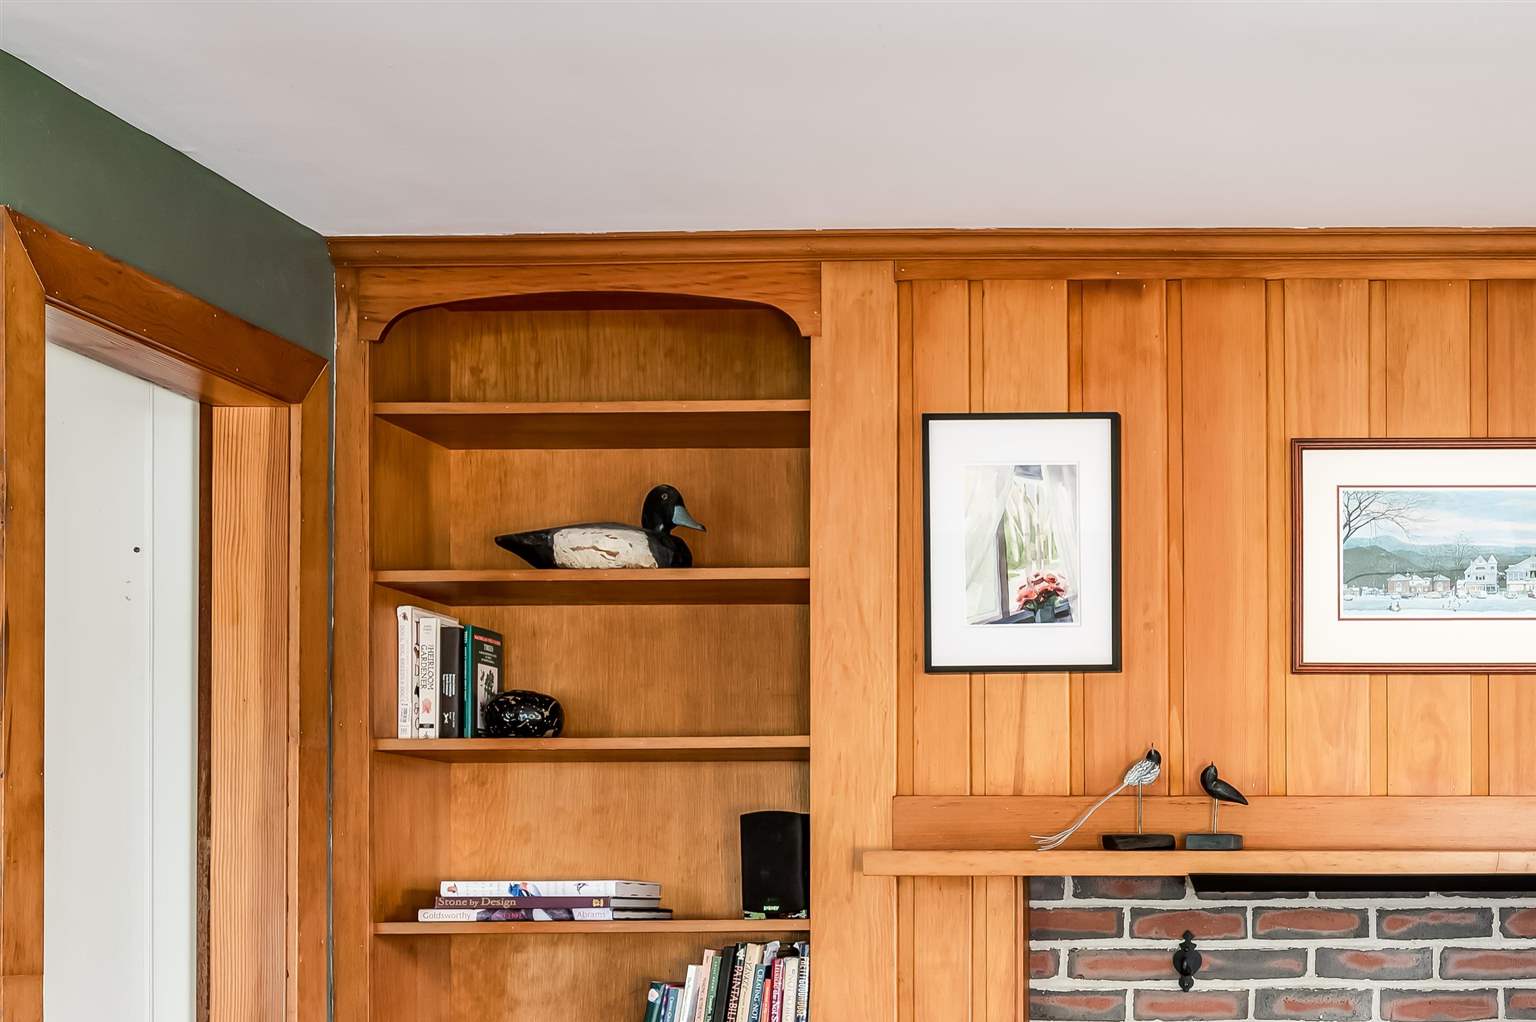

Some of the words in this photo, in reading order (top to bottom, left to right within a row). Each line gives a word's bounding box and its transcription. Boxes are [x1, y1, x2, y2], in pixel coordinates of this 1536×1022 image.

[438, 898, 467, 906] Stone
[469, 898, 478, 907] by
[481, 898, 516, 908] Design
[422, 911, 471, 920] Goldsworthy
[752, 968, 763, 1002] CREATING
